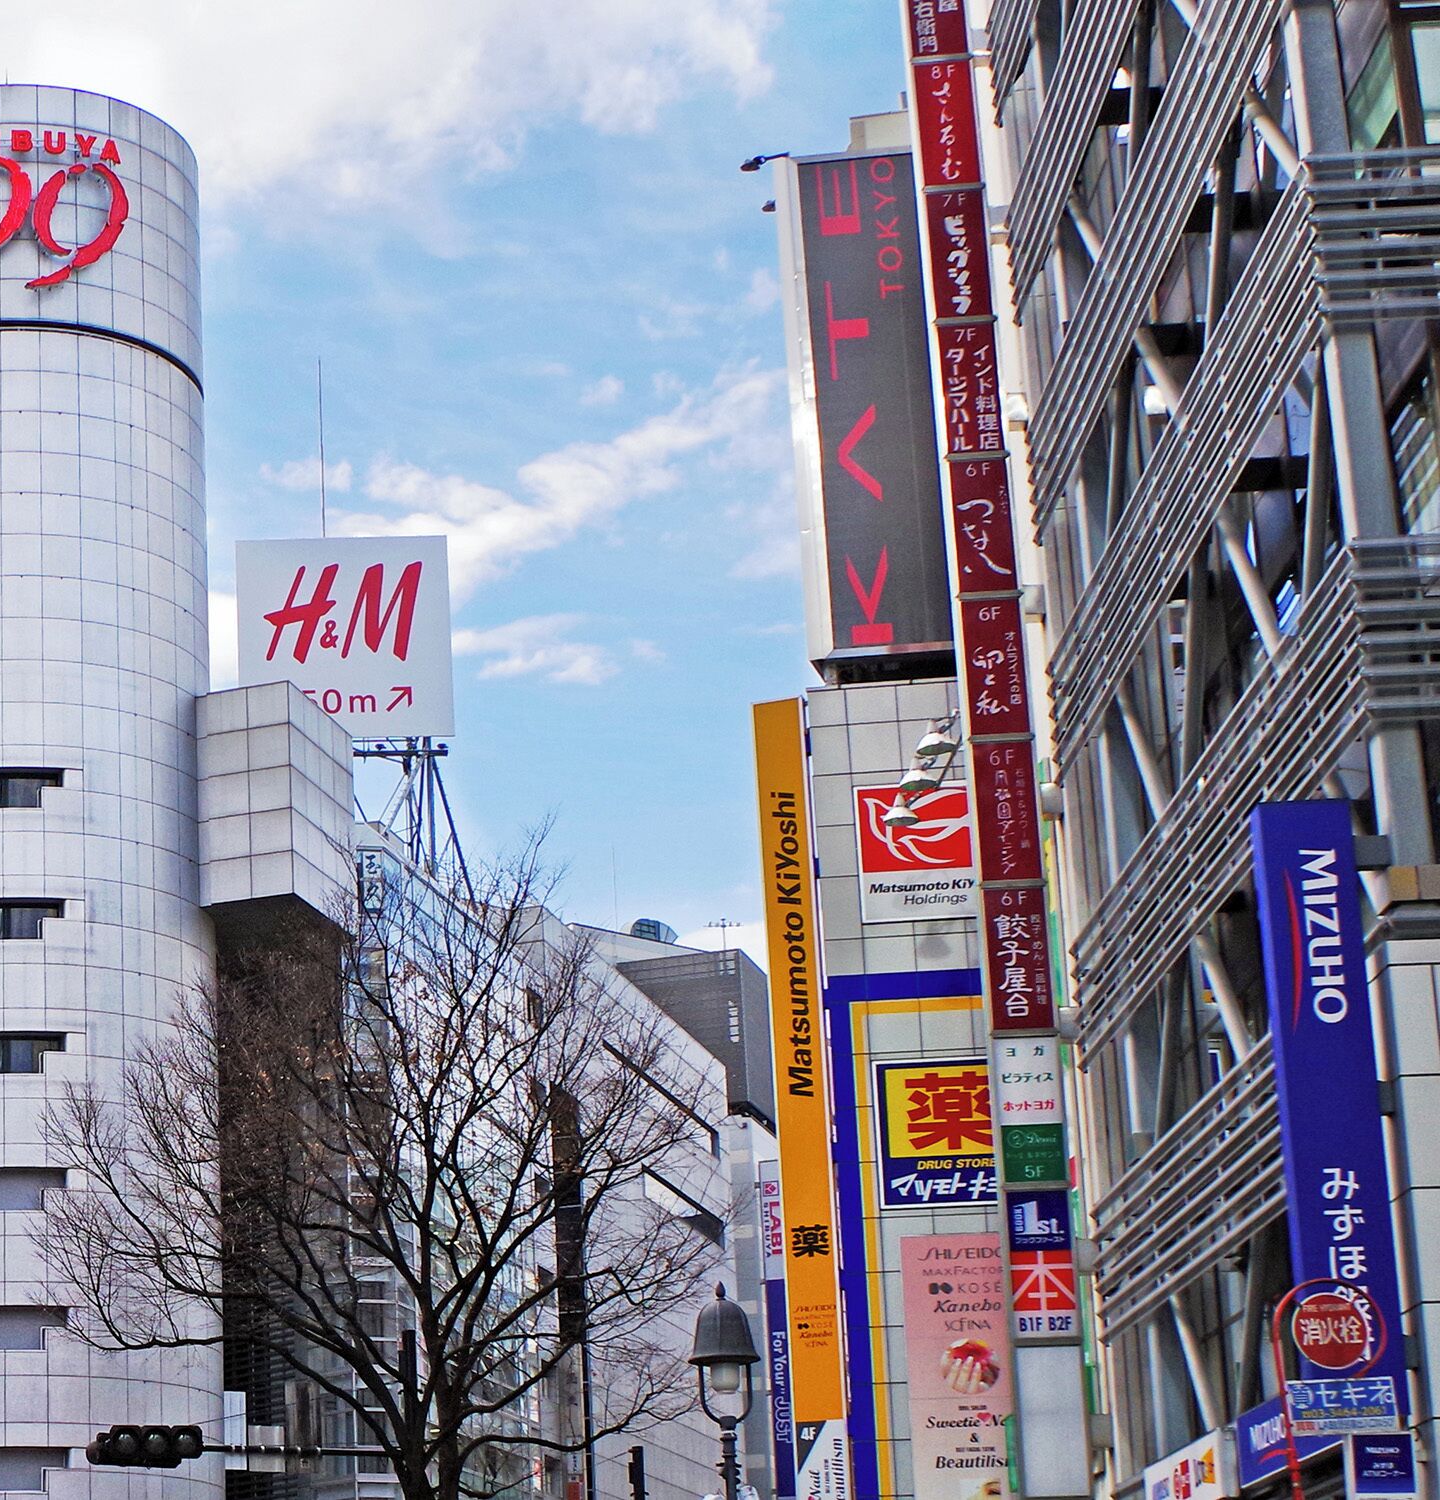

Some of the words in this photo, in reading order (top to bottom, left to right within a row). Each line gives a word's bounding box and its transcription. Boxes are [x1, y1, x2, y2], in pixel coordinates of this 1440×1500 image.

[913, 0, 938, 53] 右衛門
[931, 65, 956, 79] 8F
[943, 193, 967, 208] 7F
[870, 157, 904, 299] TOKYO
[954, 328, 976, 343] 7F
[816, 161, 893, 644] KATE
[946, 348, 973, 452] タージマハール
[973, 344, 1000, 451] インド料理店
[966, 462, 991, 476] 6F
[264, 561, 422, 664] H&M
[979, 606, 1001, 621] 6F
[989, 749, 1014, 766] 6F
[869, 879, 949, 895] Matsumoto
[904, 892, 968, 906] Holdings
[1001, 891, 1027, 906] 6F
[1298, 848, 1348, 1024] MIZUHO
[993, 913, 1033, 1017] 餃子屋台
[784, 911, 814, 1097] Matsumoto
[1002, 1072, 1054, 1083] ピラティス
[905, 1071, 993, 1151] 薬
[1003, 1099, 1055, 1111] ホットヨガ
[917, 1160, 952, 1170] DRUG
[1024, 1165, 1045, 1178] 5F
[763, 1202, 771, 1258] SHIBUYA
[769, 1202, 783, 1256] LABI
[791, 1224, 829, 1257] 薬
[934, 1300, 1002, 1313] Kanebo
[1019, 1318, 1042, 1332] B1F
[1048, 1316, 1072, 1330] B2F
[1300, 1316, 1363, 1346] 消火栓
[1316, 1381, 1394, 1408] セキネ
[926, 1416, 980, 1429] Sweetie
[801, 1426, 816, 1440] 4F
[969, 1433, 979, 1443] &
